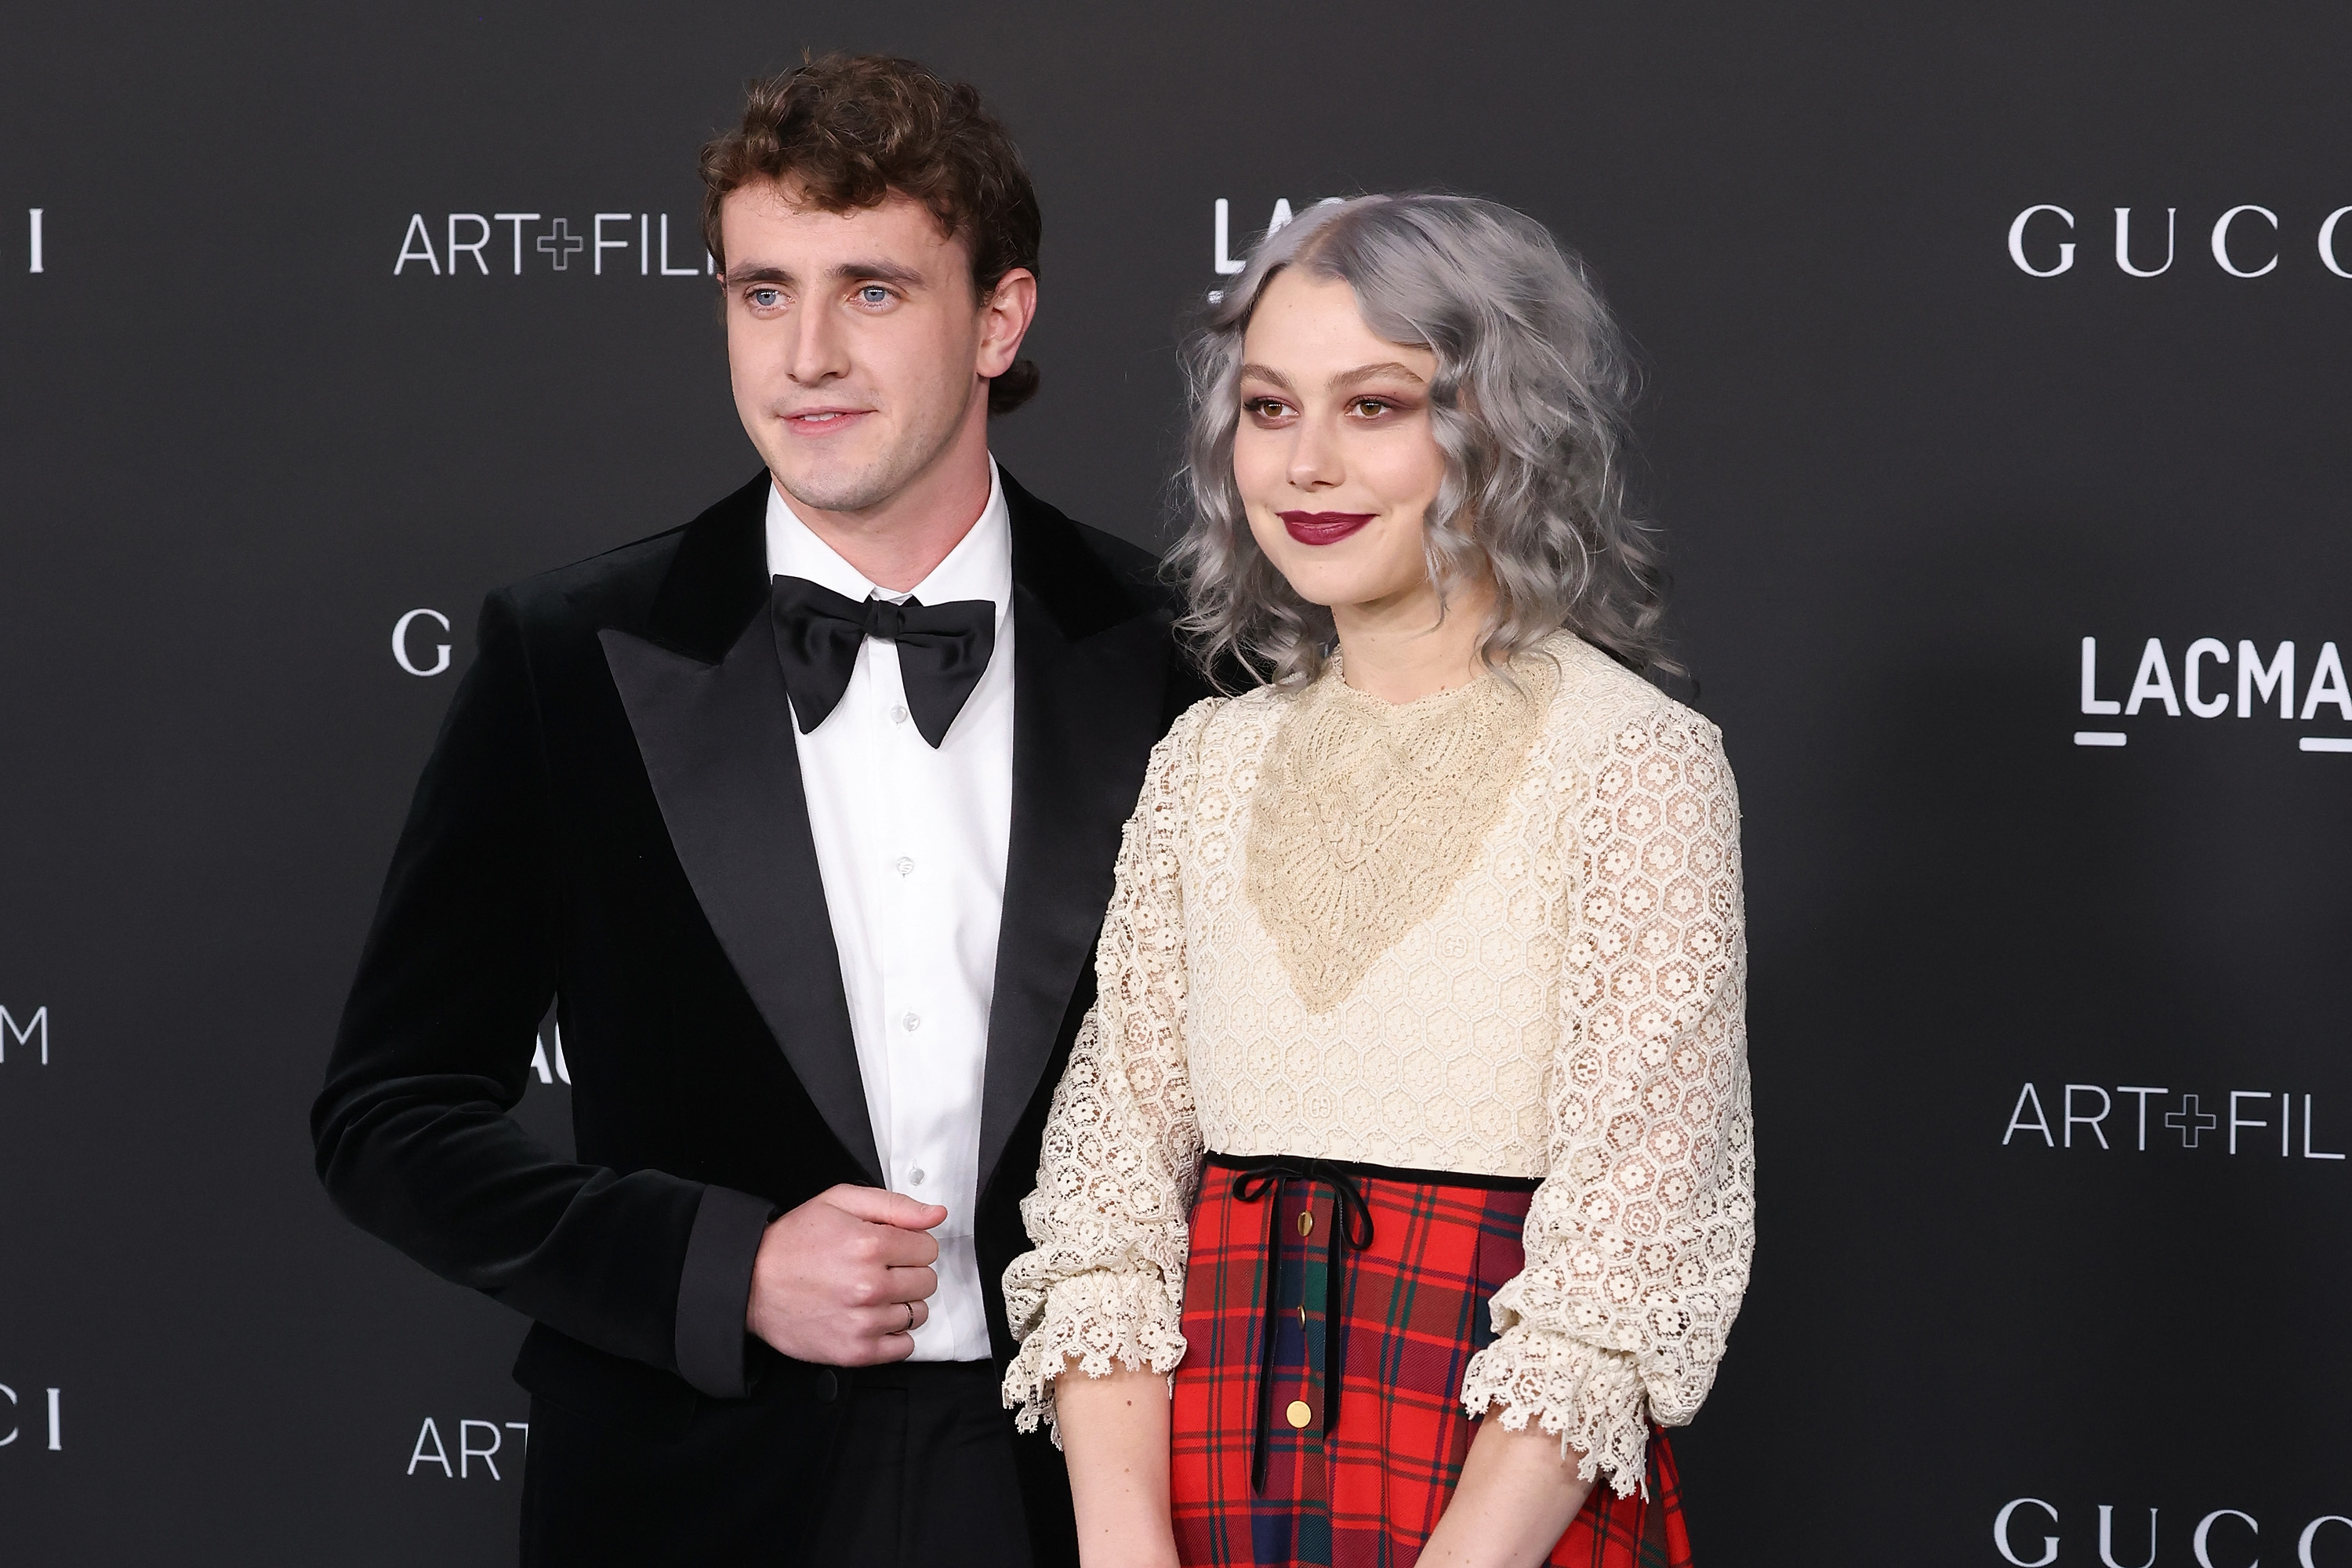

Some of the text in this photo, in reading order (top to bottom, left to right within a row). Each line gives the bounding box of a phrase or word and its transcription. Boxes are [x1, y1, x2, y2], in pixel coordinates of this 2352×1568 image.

[393, 212, 714, 276] ART+FIL
[2081, 636, 2352, 721] LACMA
[2002, 1082, 2347, 1160] ART+FIL
[0, 1382, 63, 1451] I
[1994, 1497, 2352, 1568] GUCC
